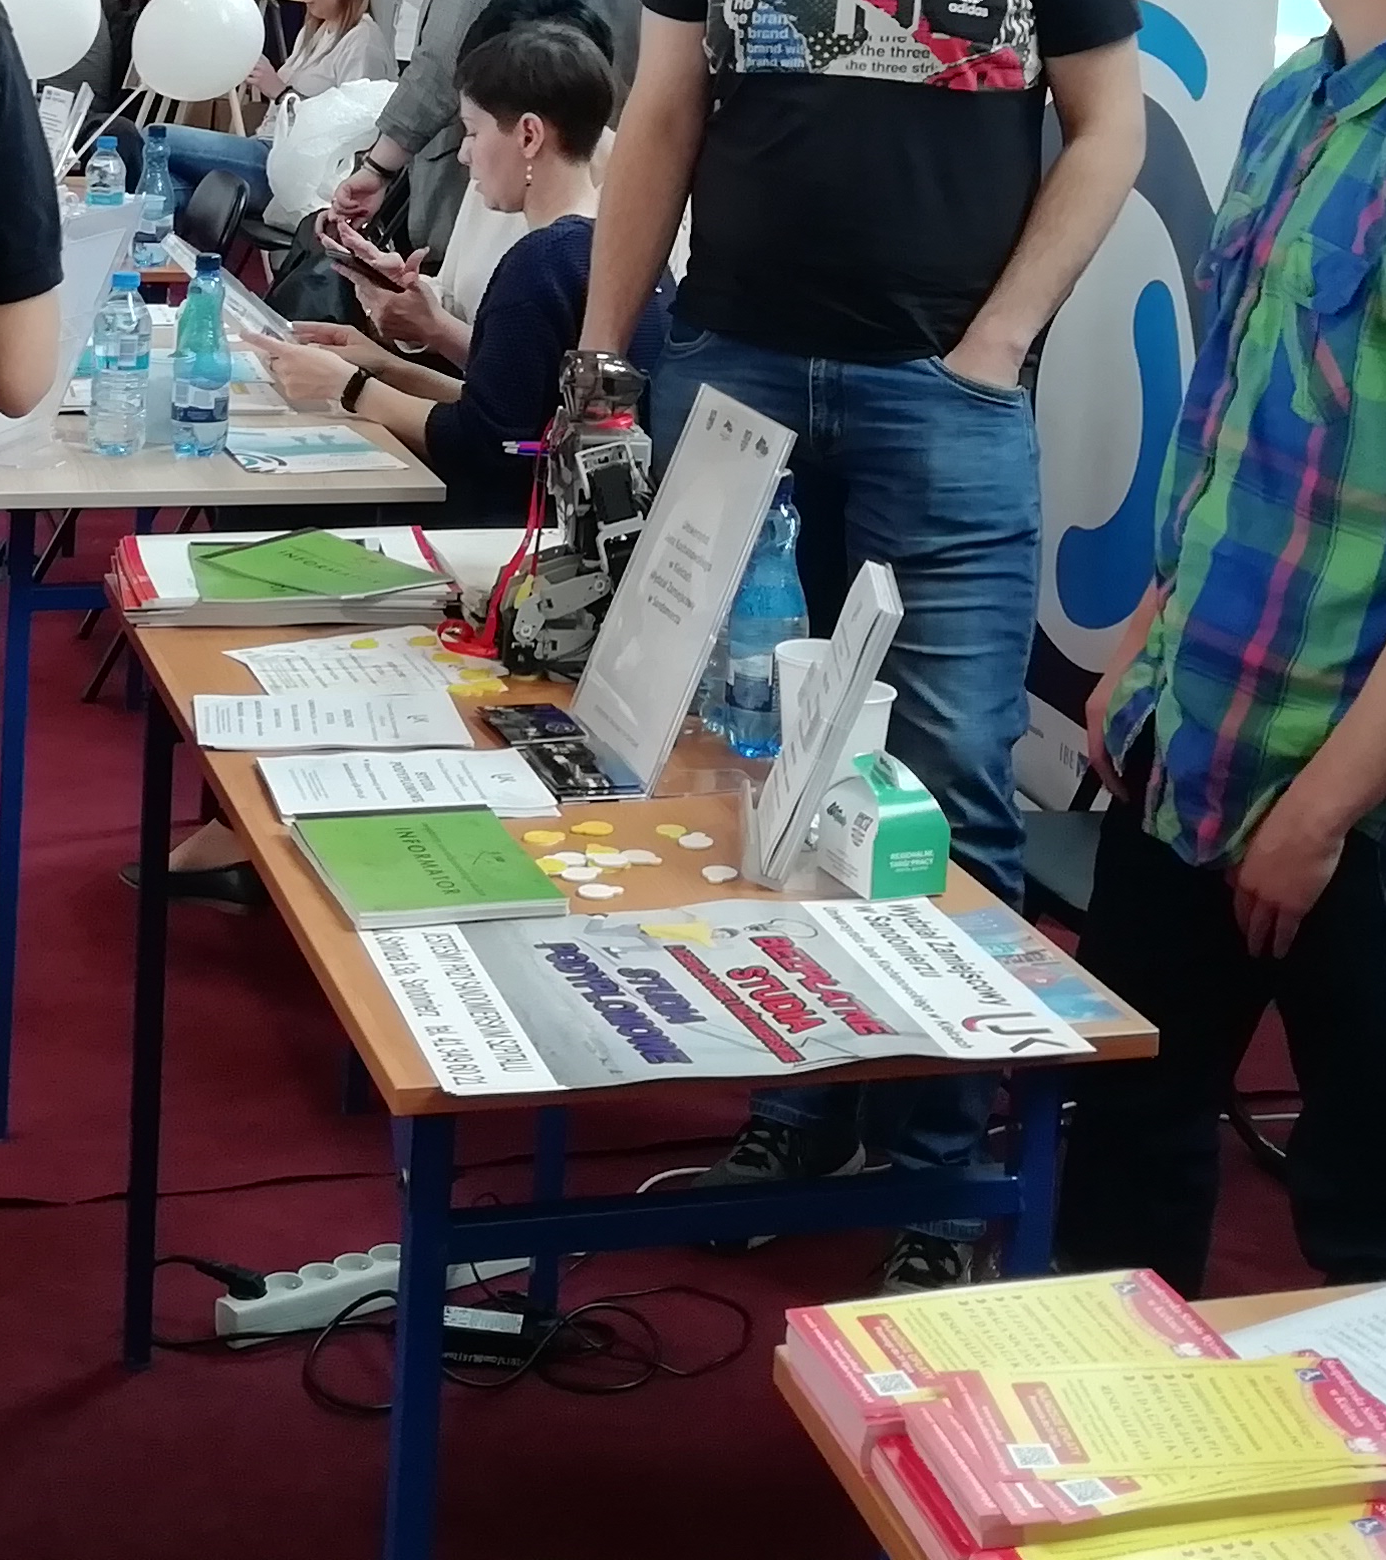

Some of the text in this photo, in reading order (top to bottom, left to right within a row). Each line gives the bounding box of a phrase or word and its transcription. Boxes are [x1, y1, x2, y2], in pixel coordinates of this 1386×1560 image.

[948, 2, 989, 17] adidas
[871, 61, 908, 74] three
[891, 46, 930, 59] three
[395, 827, 461, 896] INFORMATOR
[860, 914, 943, 978] Sandomierzu
[886, 903, 948, 939] Wydział
[923, 940, 1012, 1007] Zamiejscowy
[533, 942, 691, 1064] PODYPLOMOWE
[614, 967, 707, 1023] STUDIA
[720, 965, 831, 1034] STUDIA
[748, 936, 899, 1036] BEZPŁATNE
